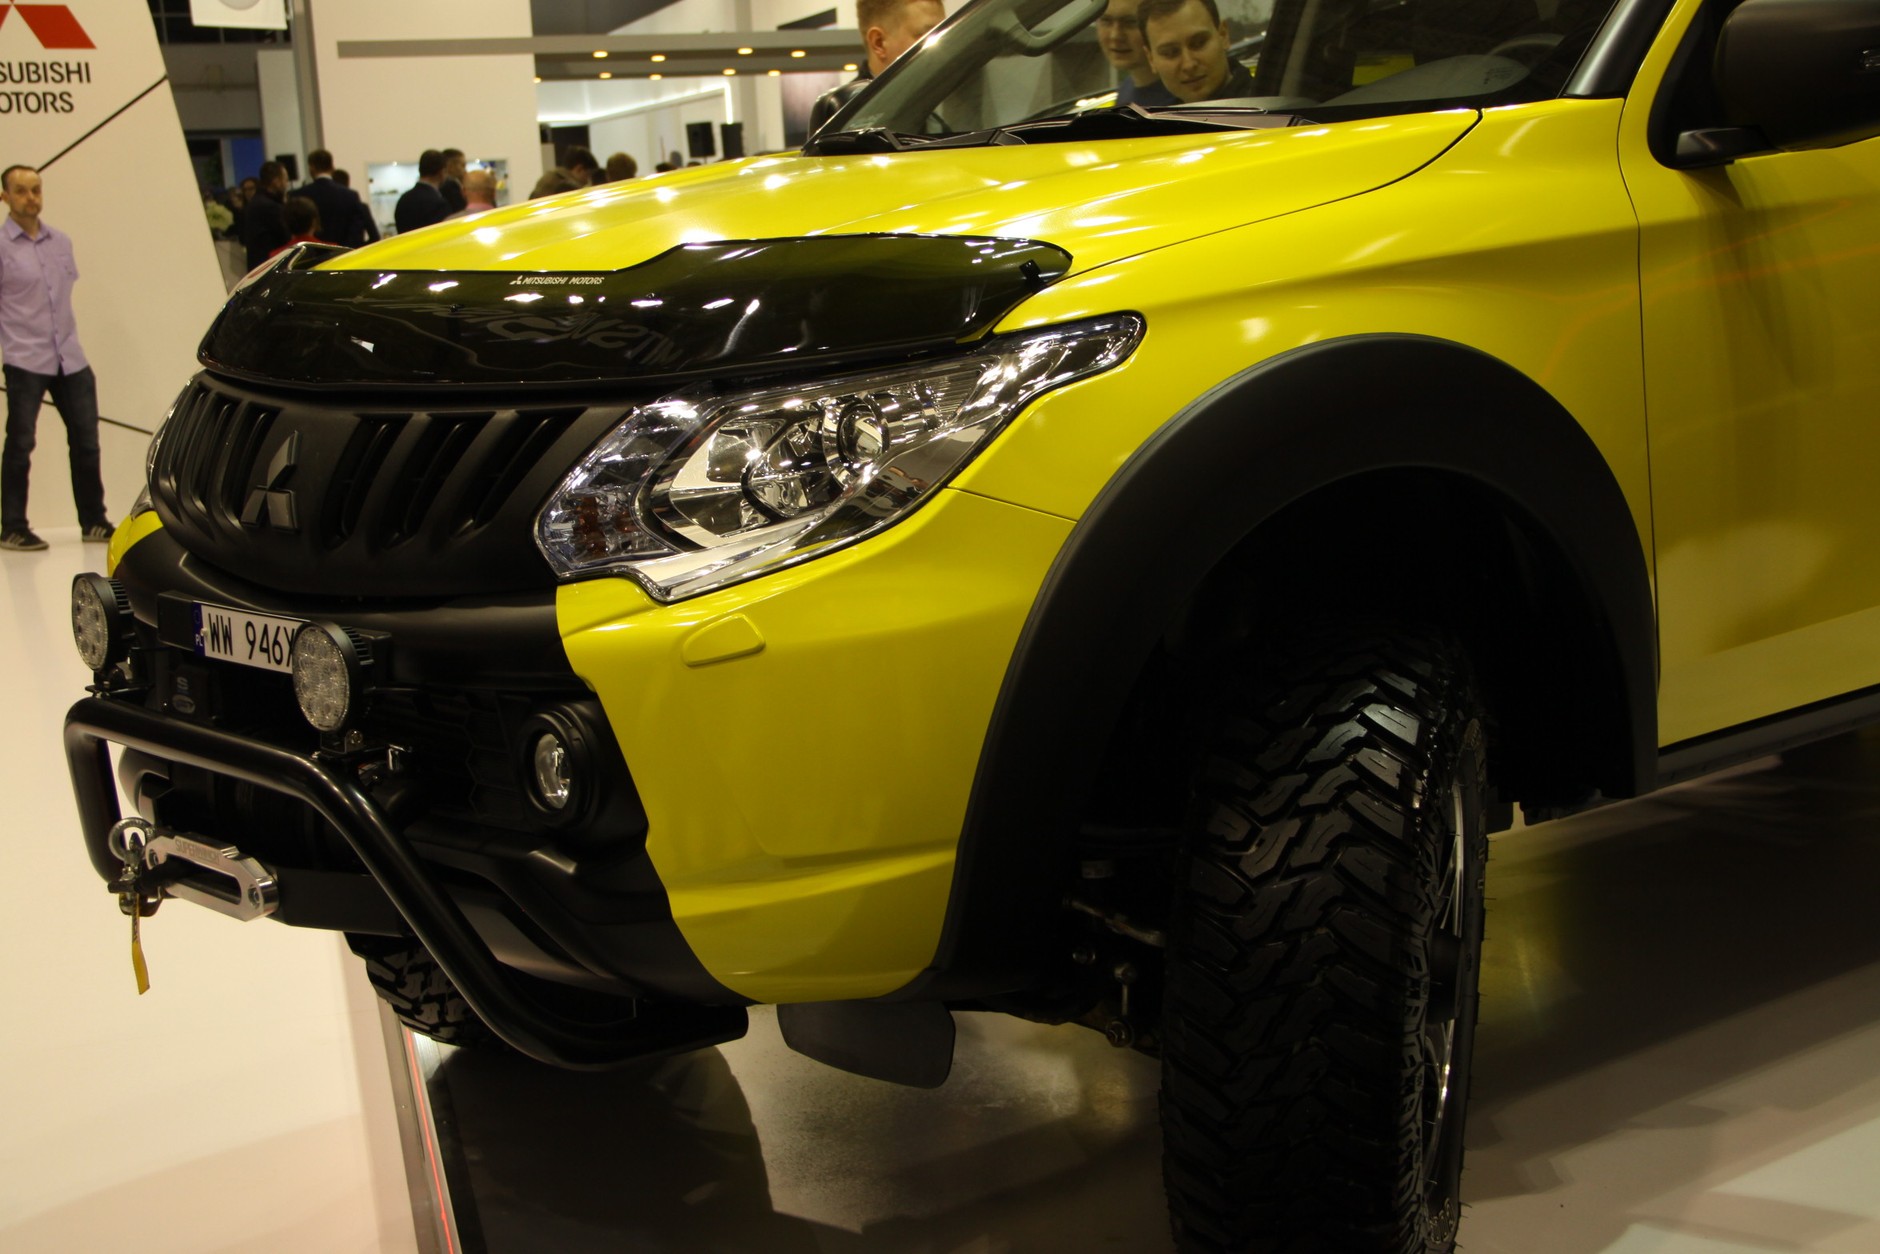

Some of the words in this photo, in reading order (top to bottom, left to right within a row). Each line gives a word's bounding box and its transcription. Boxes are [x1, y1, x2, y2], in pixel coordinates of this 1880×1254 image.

[522, 277, 568, 285] MITSUBISHI
[569, 277, 604, 285] MOTORS
[207, 612, 234, 656] WW
